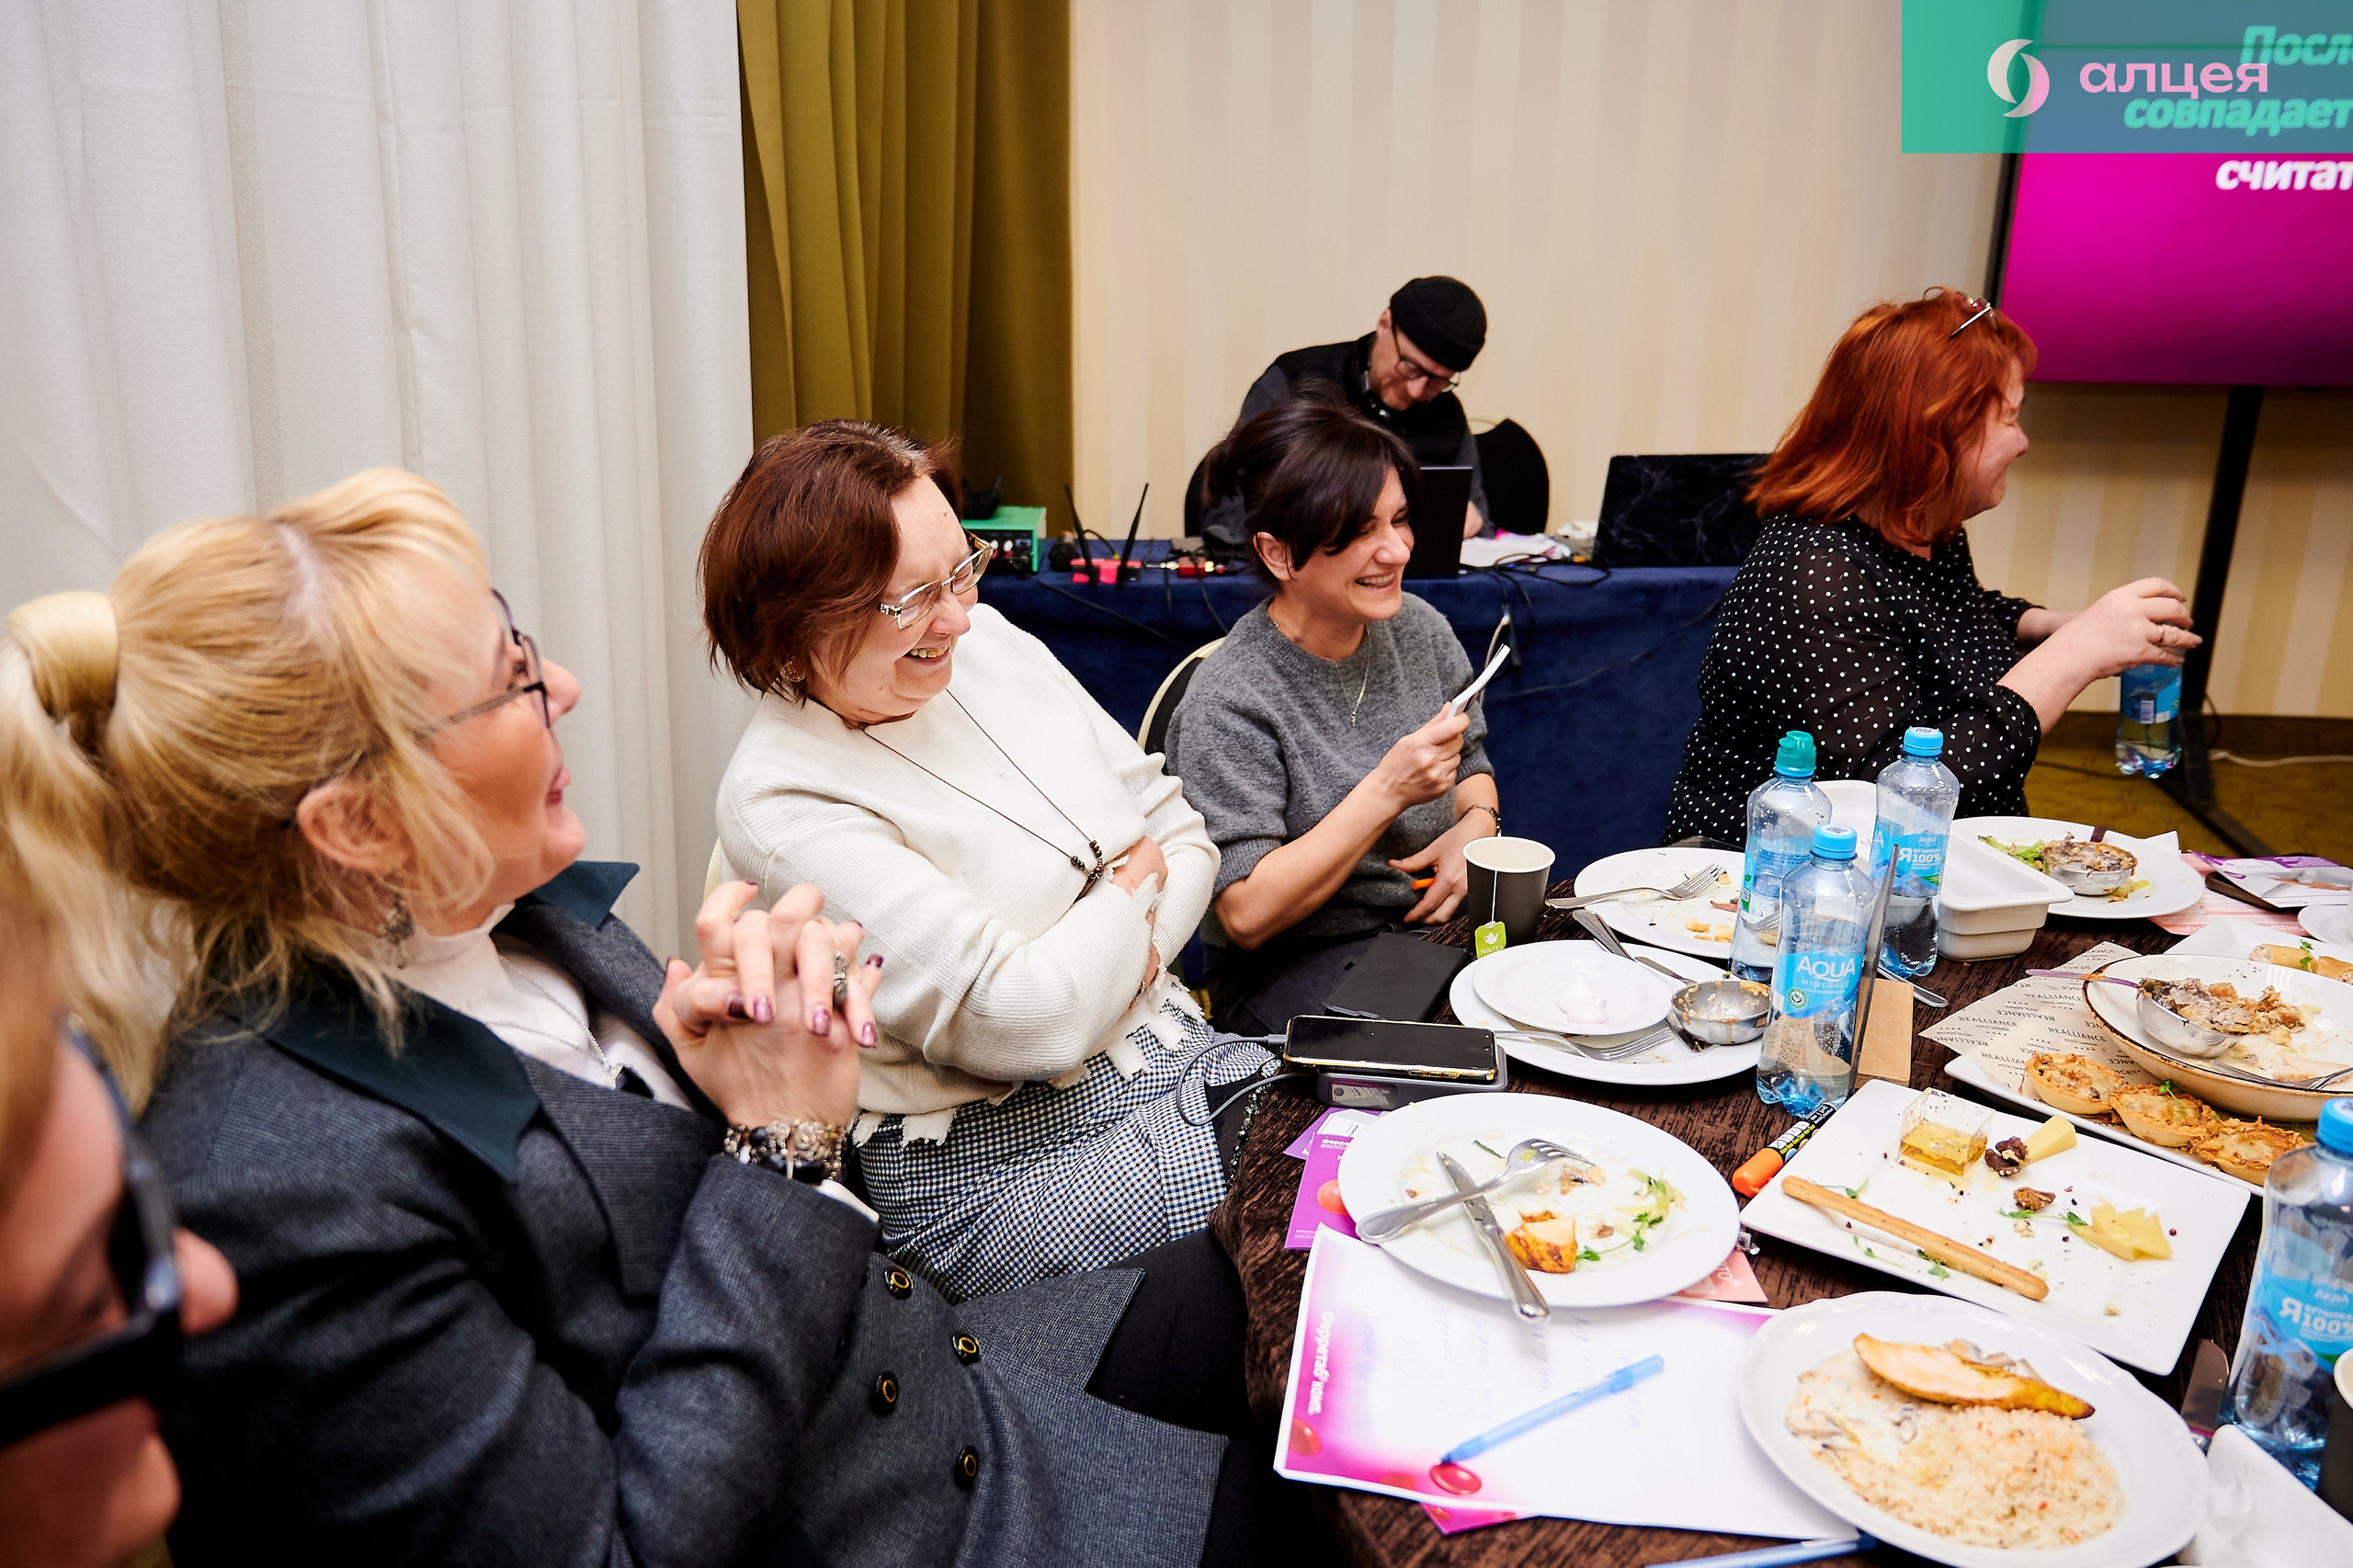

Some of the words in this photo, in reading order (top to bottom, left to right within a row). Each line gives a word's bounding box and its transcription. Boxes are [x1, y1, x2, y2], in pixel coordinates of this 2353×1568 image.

[2240, 25, 2353, 66] Посл
[2123, 98, 2353, 137] совпадает
[1899, 846, 1913, 862] Я
[1913, 853, 1941, 863] 100%
[1481, 945, 1505, 954] NIKTEA
[1796, 955, 1856, 983] AQUA
[1801, 978, 1851, 989] MINERALE
[1958, 1016, 2019, 1028] REALLIANCE
[2048, 1027, 2108, 1042] REALLIANCE
[2279, 1296, 2303, 1324] Я
